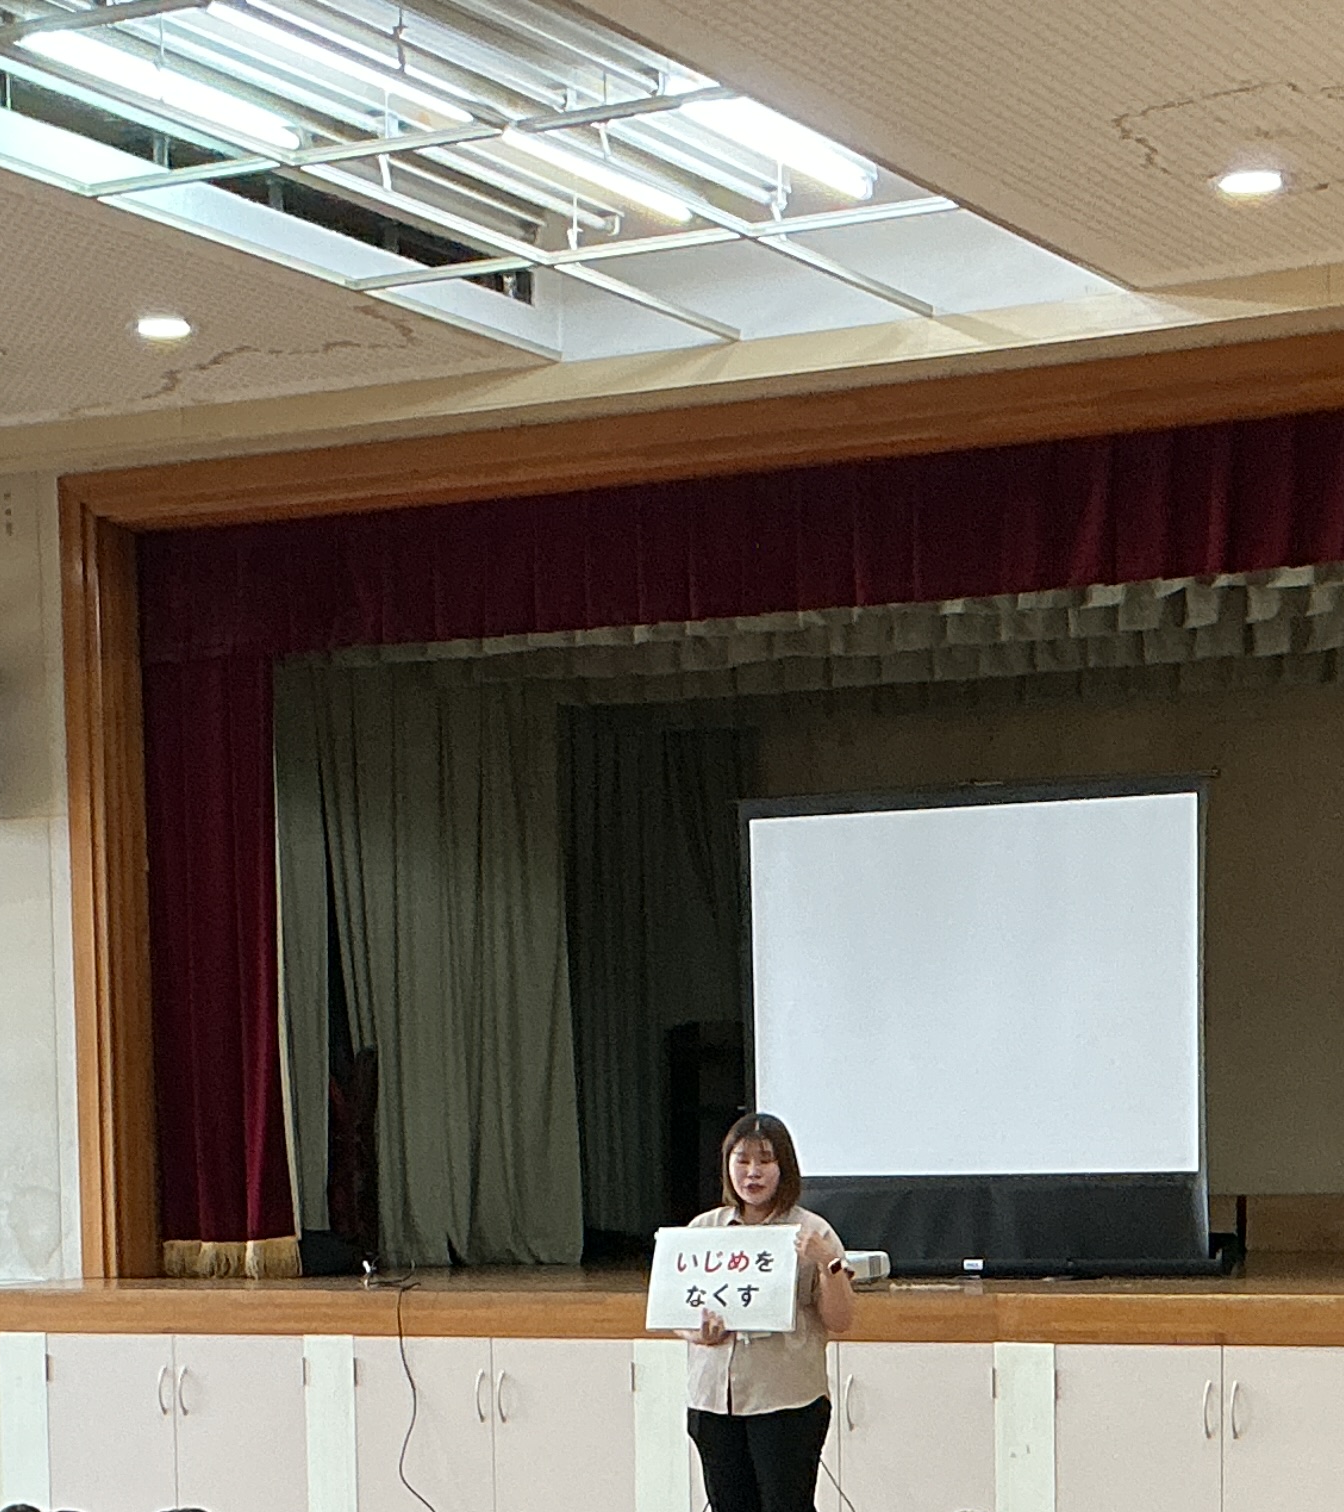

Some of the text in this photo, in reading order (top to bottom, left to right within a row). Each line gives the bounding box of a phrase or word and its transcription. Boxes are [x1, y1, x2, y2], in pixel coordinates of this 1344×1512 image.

[677, 1250, 774, 1273] いじめを
[685, 1283, 760, 1308] なくす
